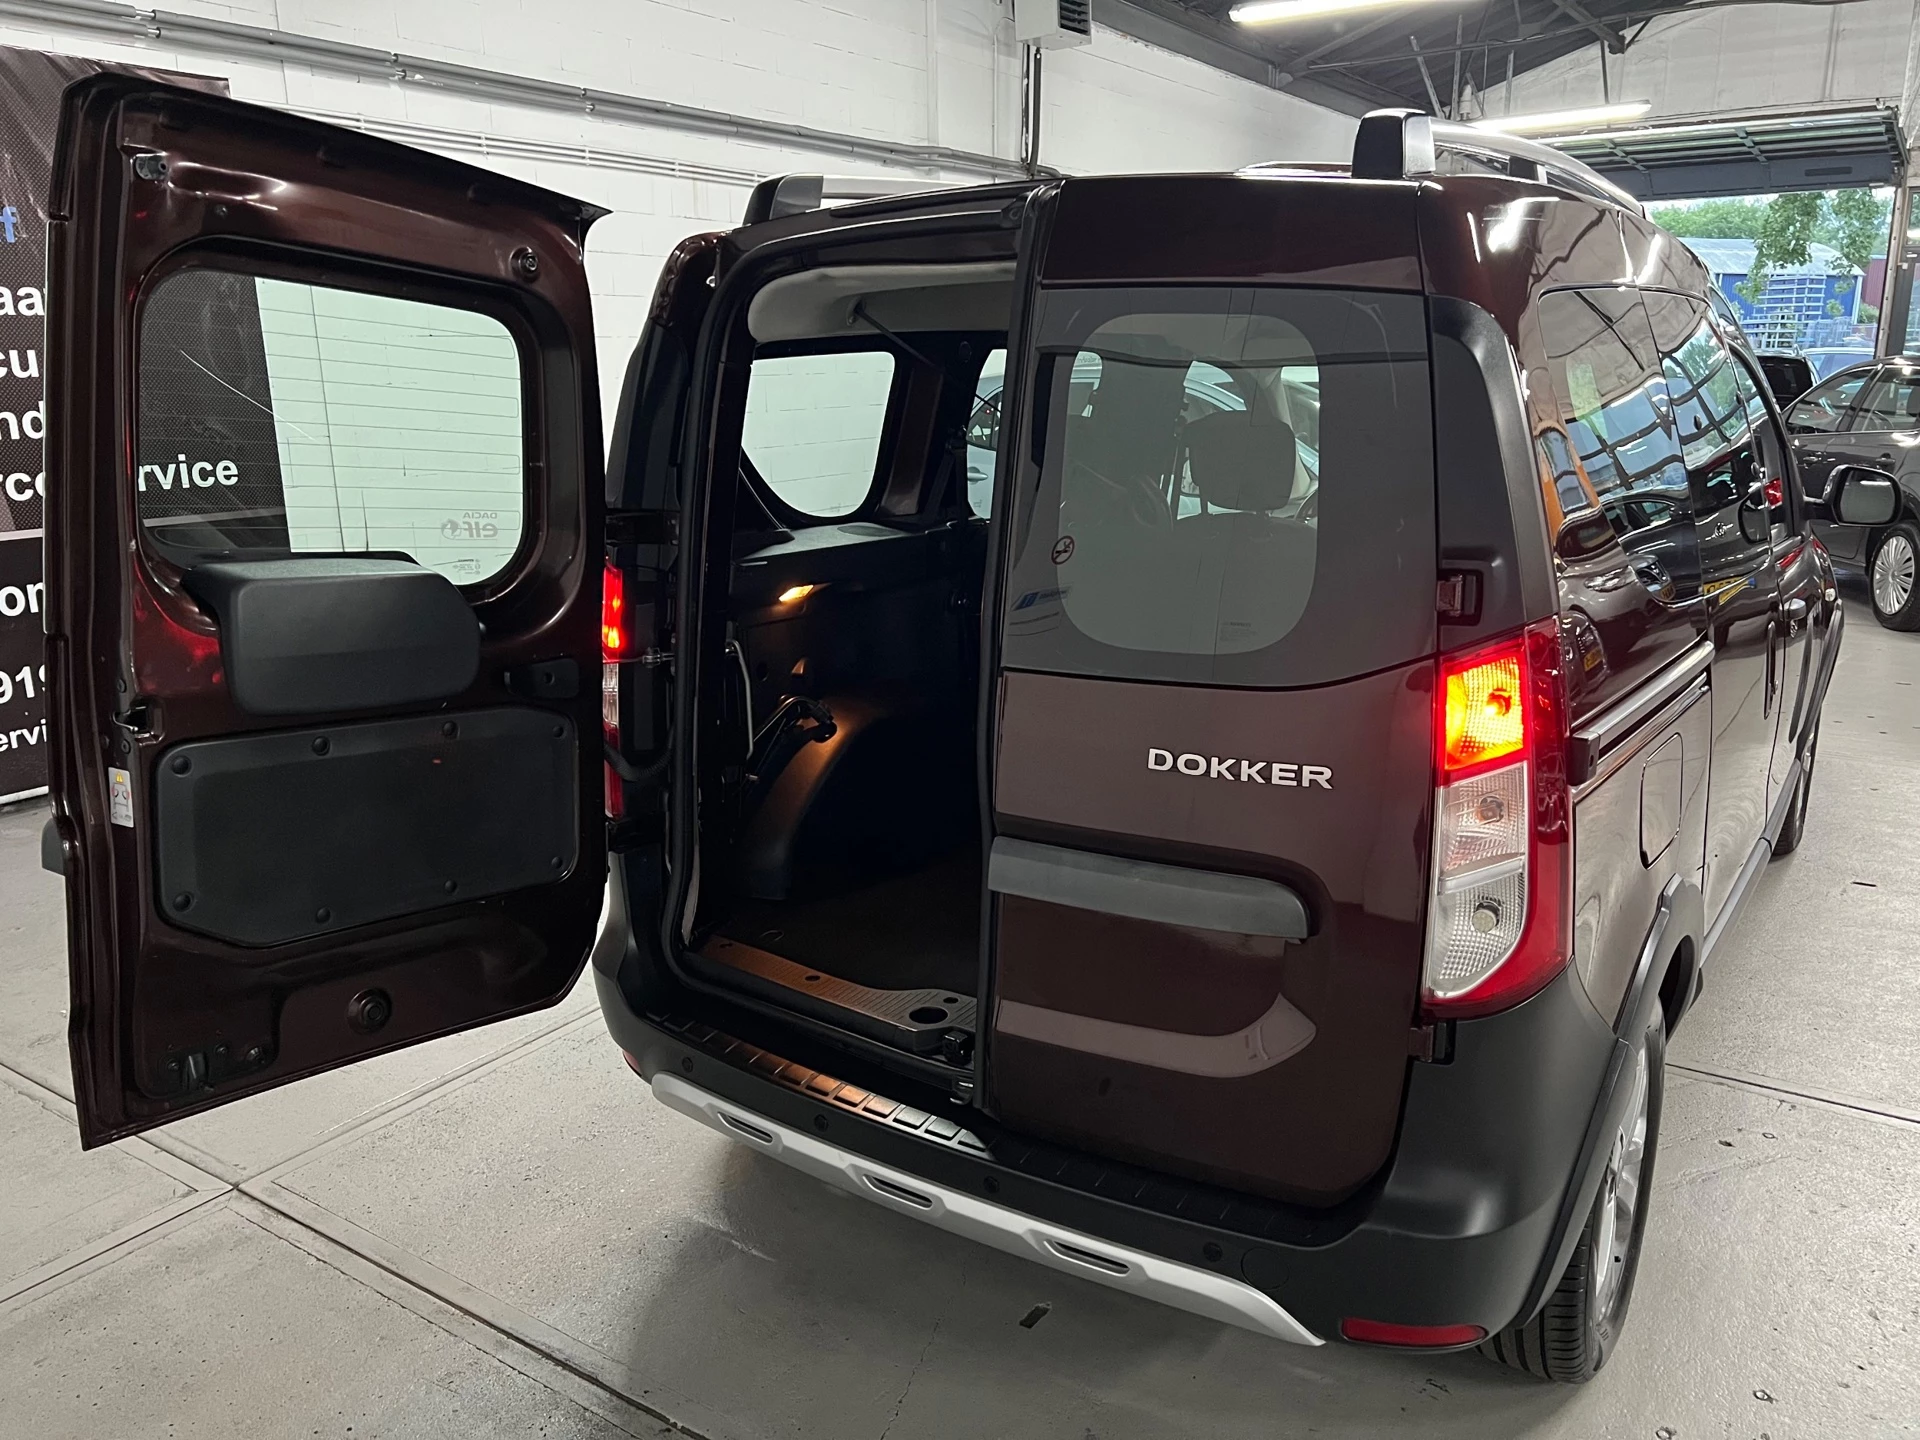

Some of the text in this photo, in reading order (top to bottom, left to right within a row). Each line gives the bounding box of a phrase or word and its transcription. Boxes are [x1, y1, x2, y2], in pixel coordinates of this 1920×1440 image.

[0, 286, 46, 316] aa
[0, 664, 45, 705] 91
[1147, 748, 1333, 789] DOKKER
